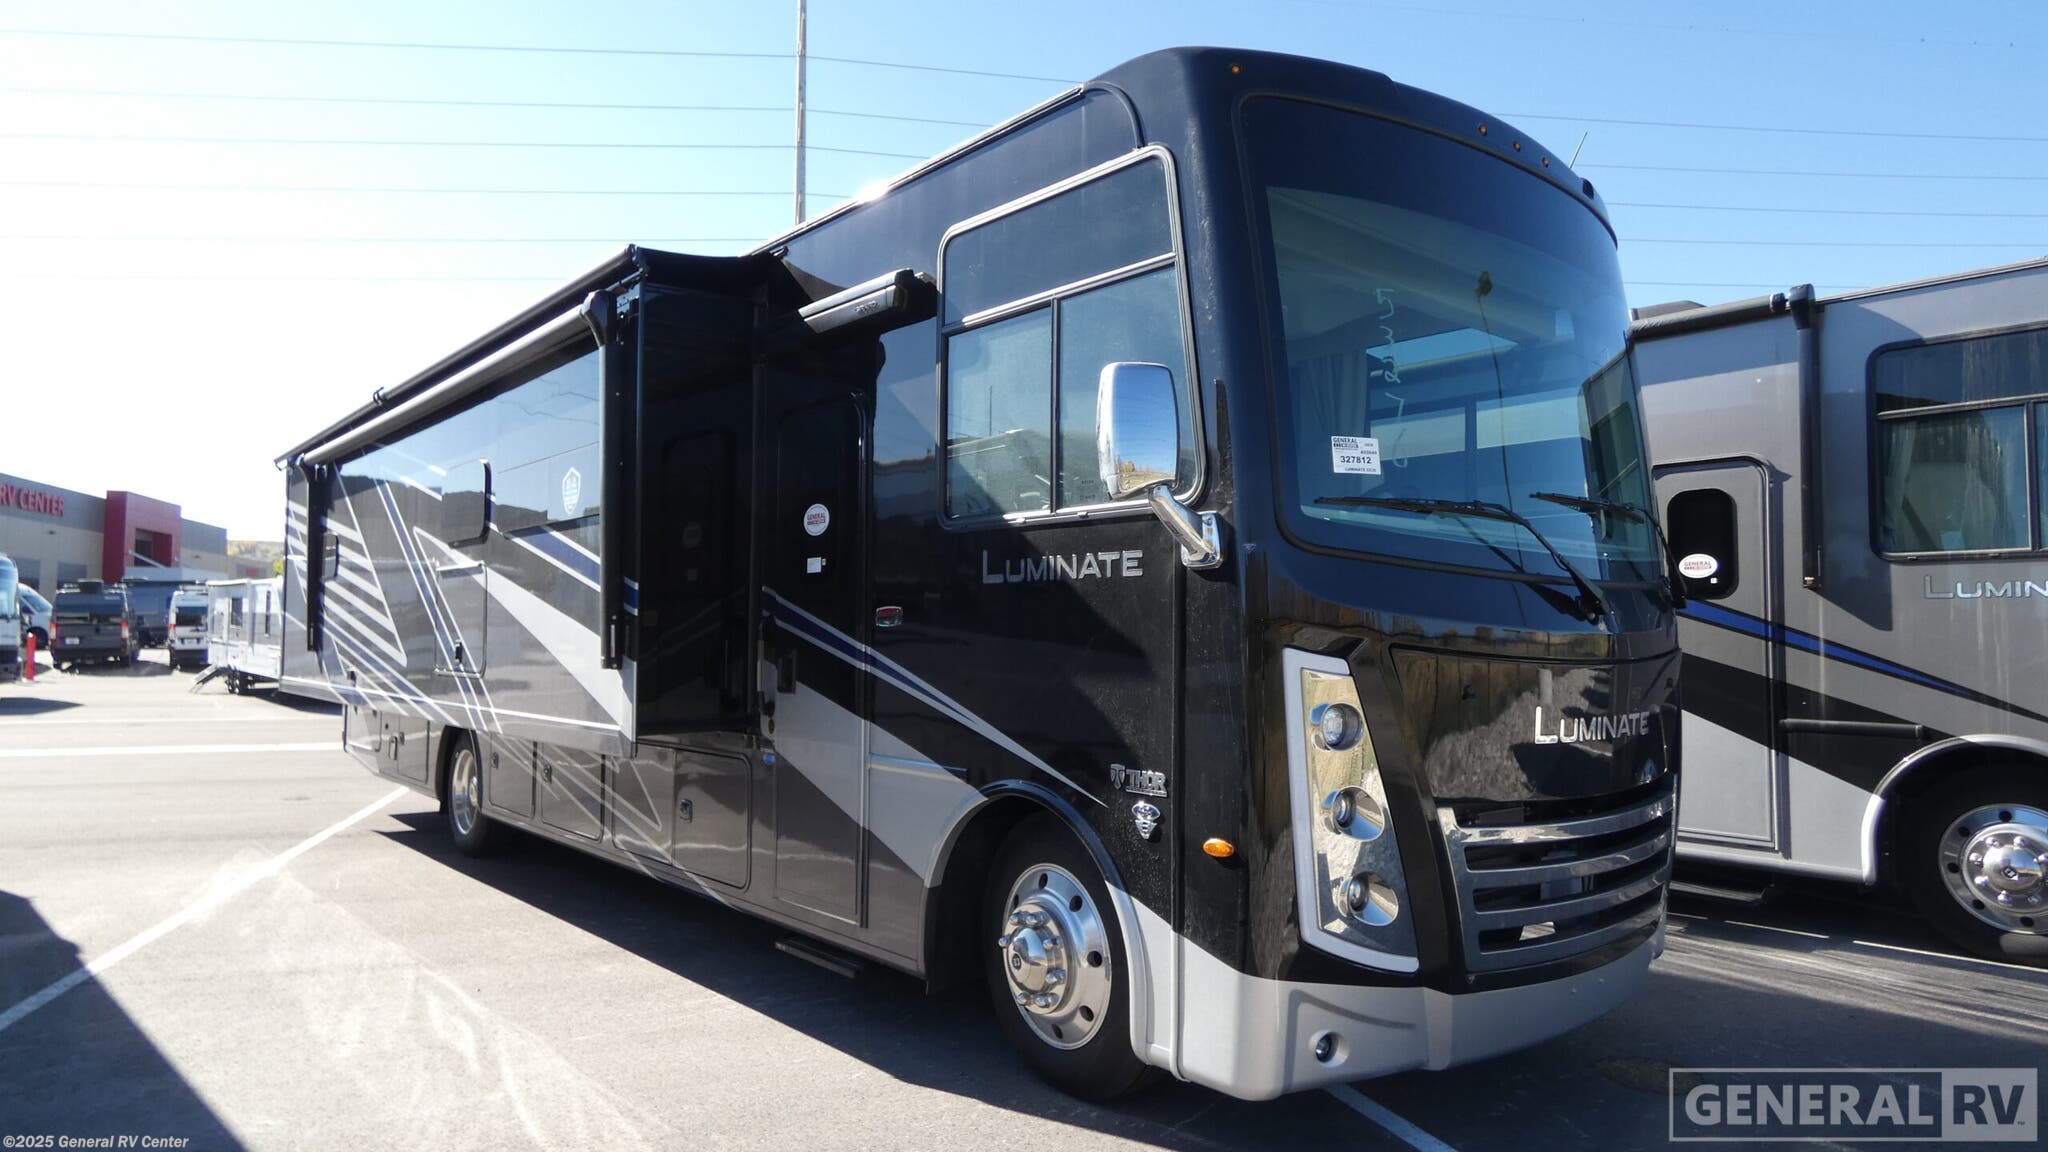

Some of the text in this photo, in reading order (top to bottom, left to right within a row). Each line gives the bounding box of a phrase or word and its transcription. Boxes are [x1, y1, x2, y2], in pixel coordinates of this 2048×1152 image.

[1340, 455, 1372, 464] 327812
[0, 483, 65, 517] RV CENTER
[982, 549, 1144, 584] LUMINATE
[1534, 705, 1650, 745] LUMINATE
[1125, 768, 1166, 792] THOR
